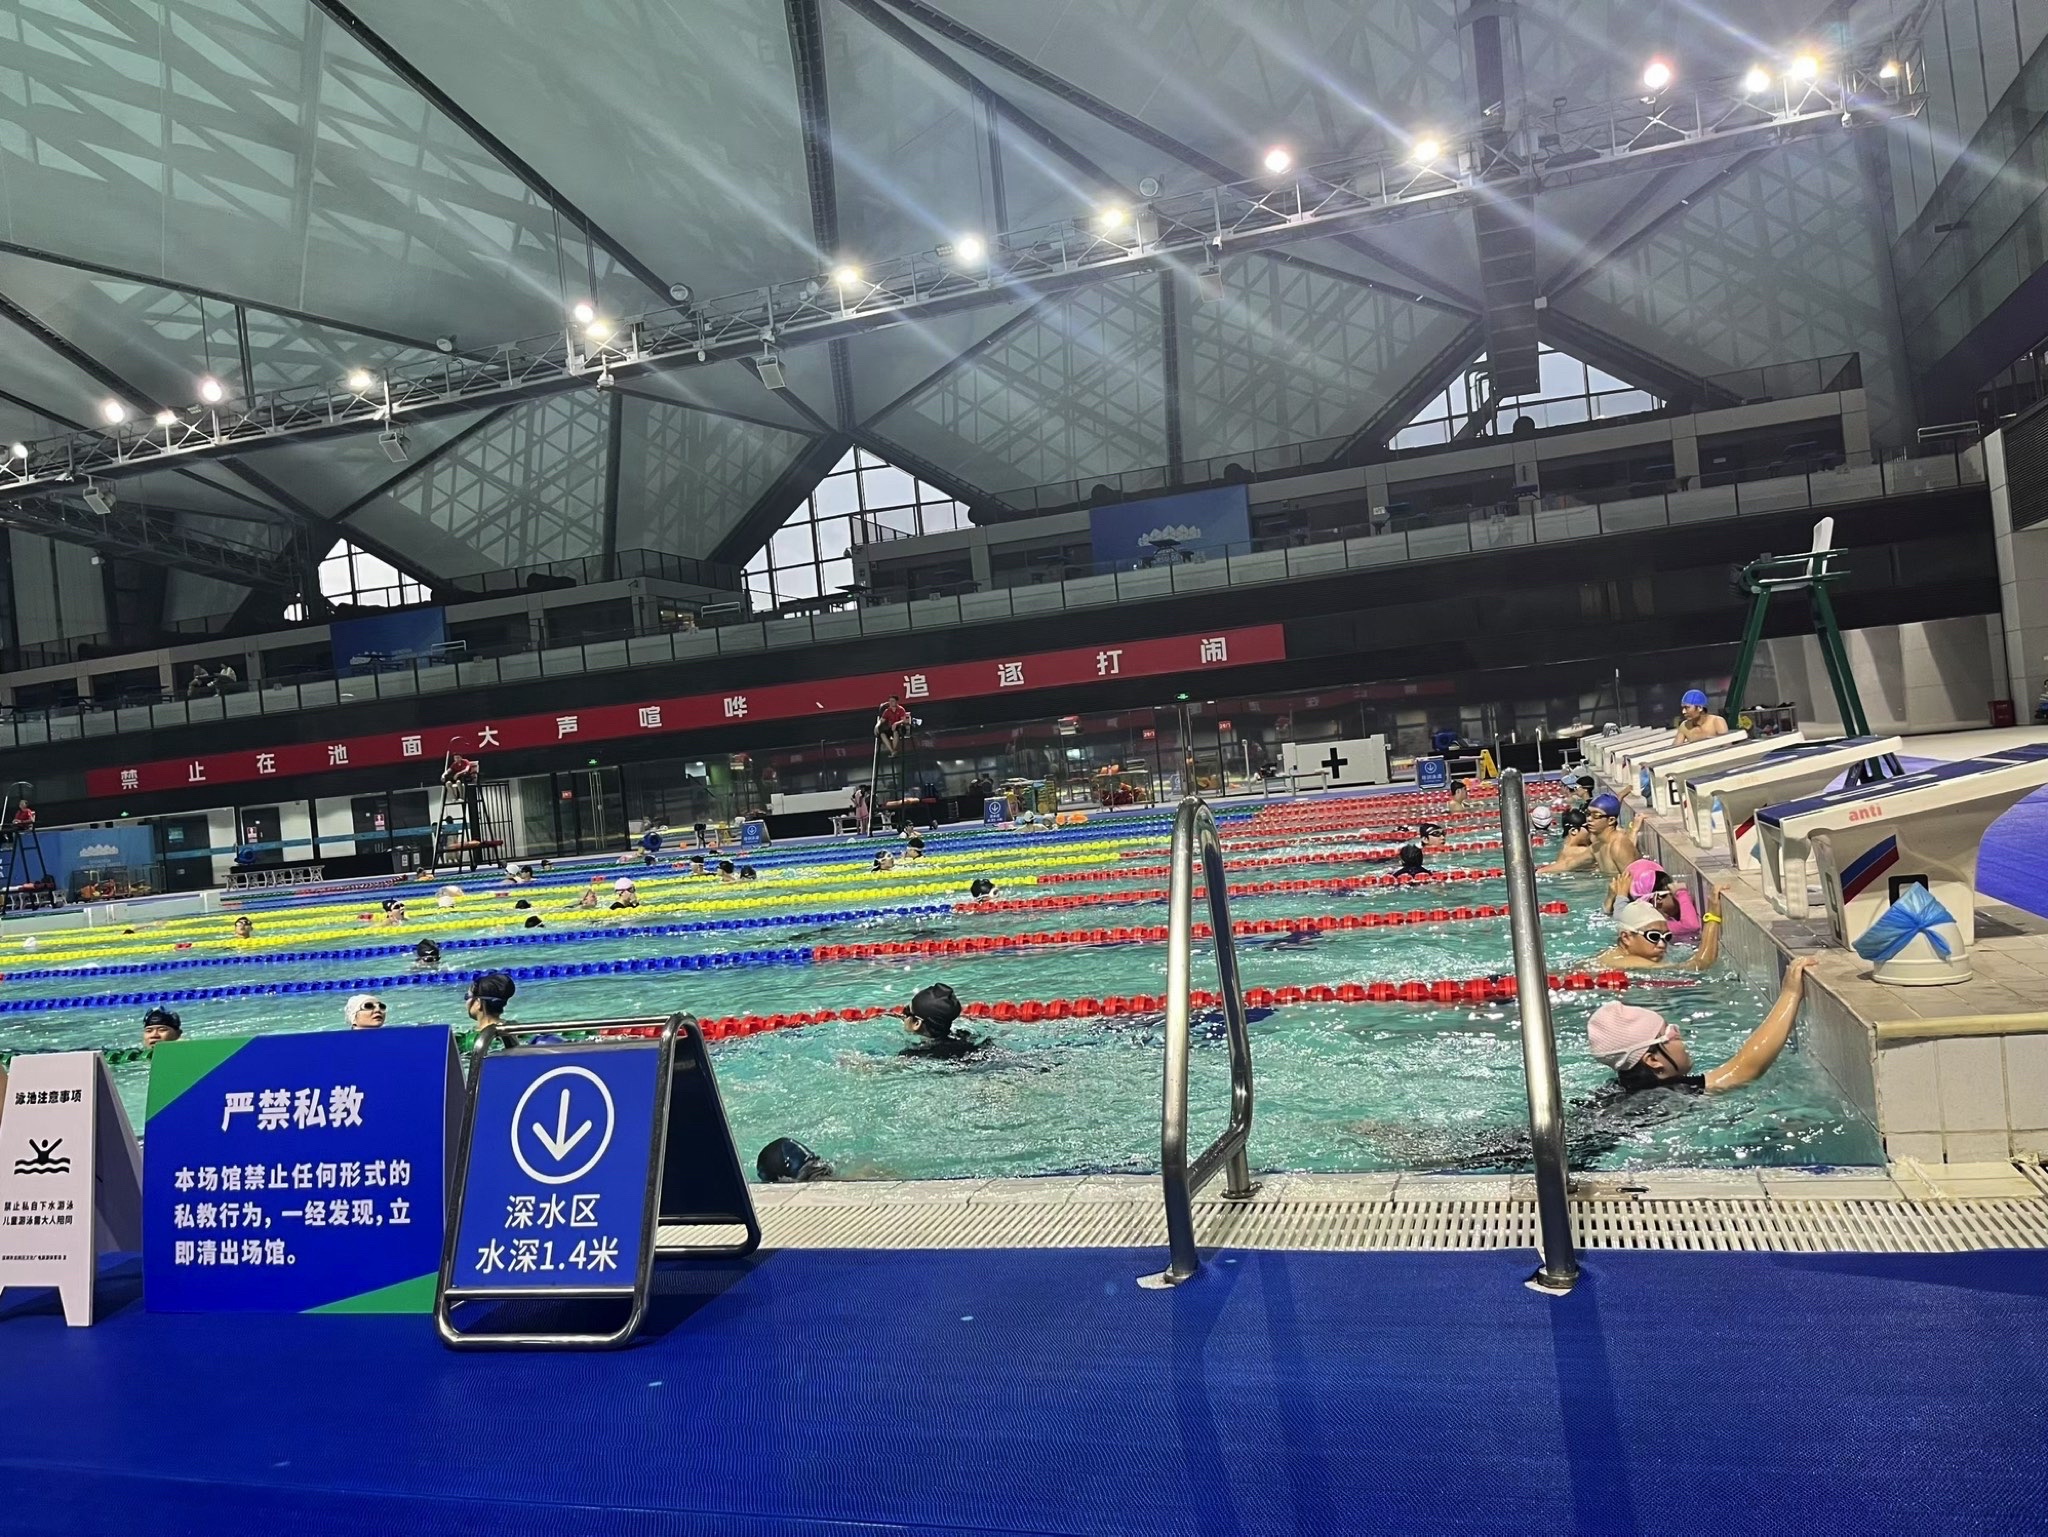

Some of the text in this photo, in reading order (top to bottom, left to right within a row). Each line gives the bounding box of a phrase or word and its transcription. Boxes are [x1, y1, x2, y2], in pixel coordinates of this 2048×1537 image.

[1849, 803, 1883, 822] anti
[14, 1089, 82, 1105] 泳池注意事项
[221, 1084, 365, 1133] 严禁私教
[174, 1160, 411, 1191] 本场馆禁止任何形式的
[4, 1200, 74, 1211] 禁止私自下水游泳
[174, 1198, 411, 1229] 私教行为，一经发现，立
[504, 1193, 600, 1229] 深水区
[174, 1239, 297, 1266] 即清出场馆。
[474, 1236, 619, 1274] 水深1.4米
